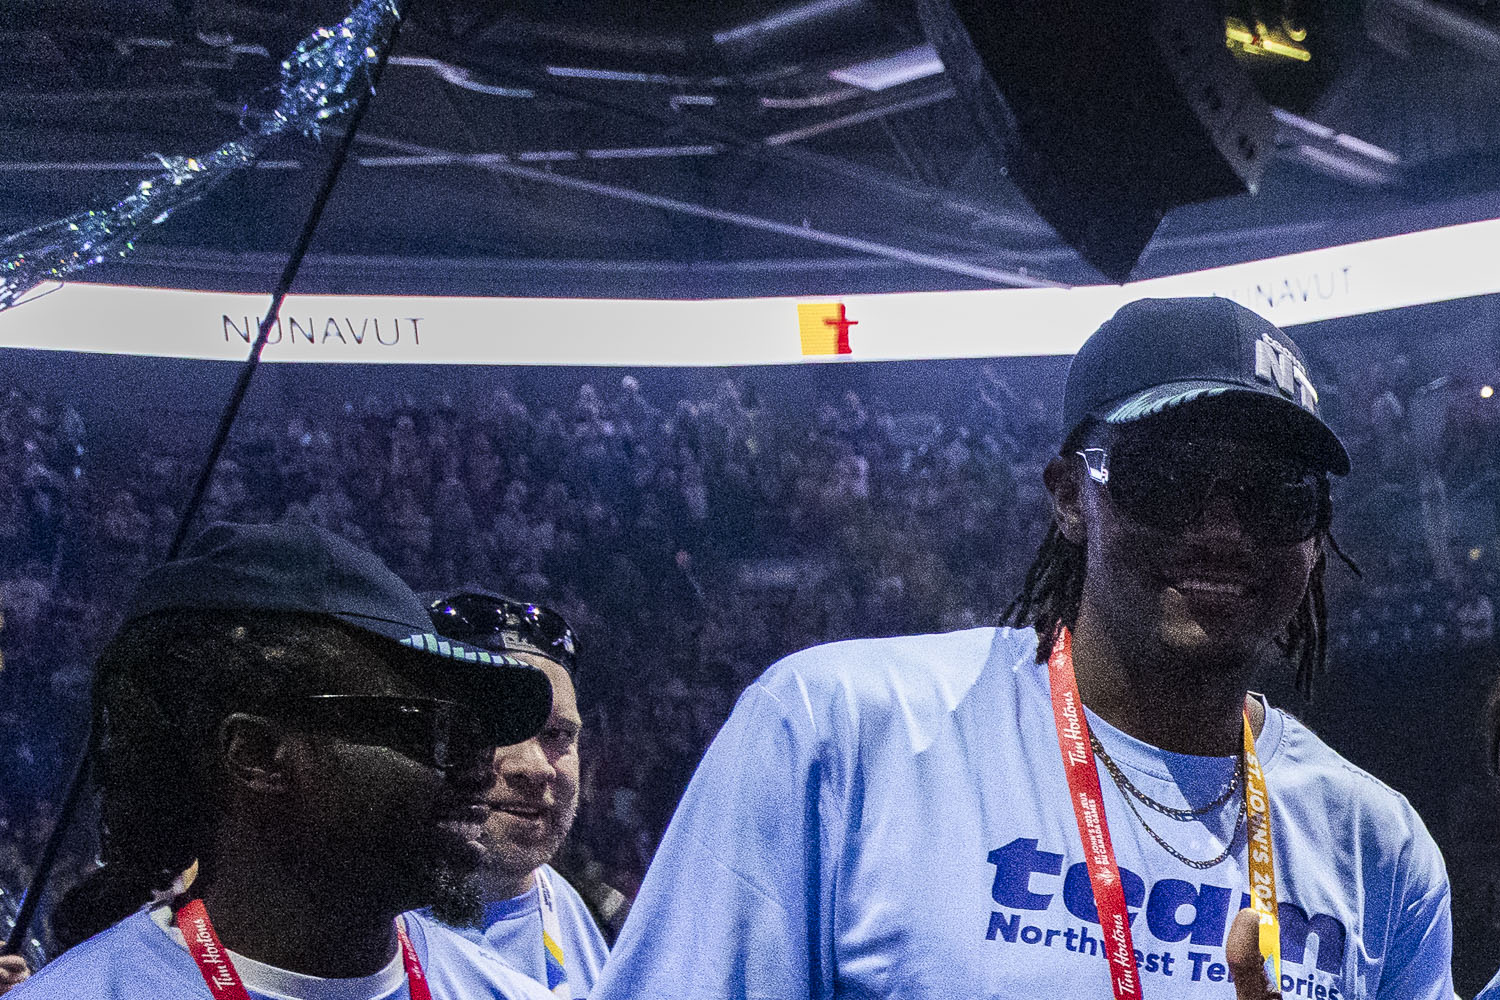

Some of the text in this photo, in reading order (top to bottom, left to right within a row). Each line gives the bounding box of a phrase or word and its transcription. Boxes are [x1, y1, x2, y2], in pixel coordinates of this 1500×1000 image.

[222, 314, 425, 346] NUNAVUT
[1063, 691, 1088, 766] Tim Hortons
[987, 837, 1347, 975] team
[192, 918, 235, 991] Tim Hortons
[986, 911, 1176, 977] Northest
[1110, 914, 1135, 995] Tim Hortons
